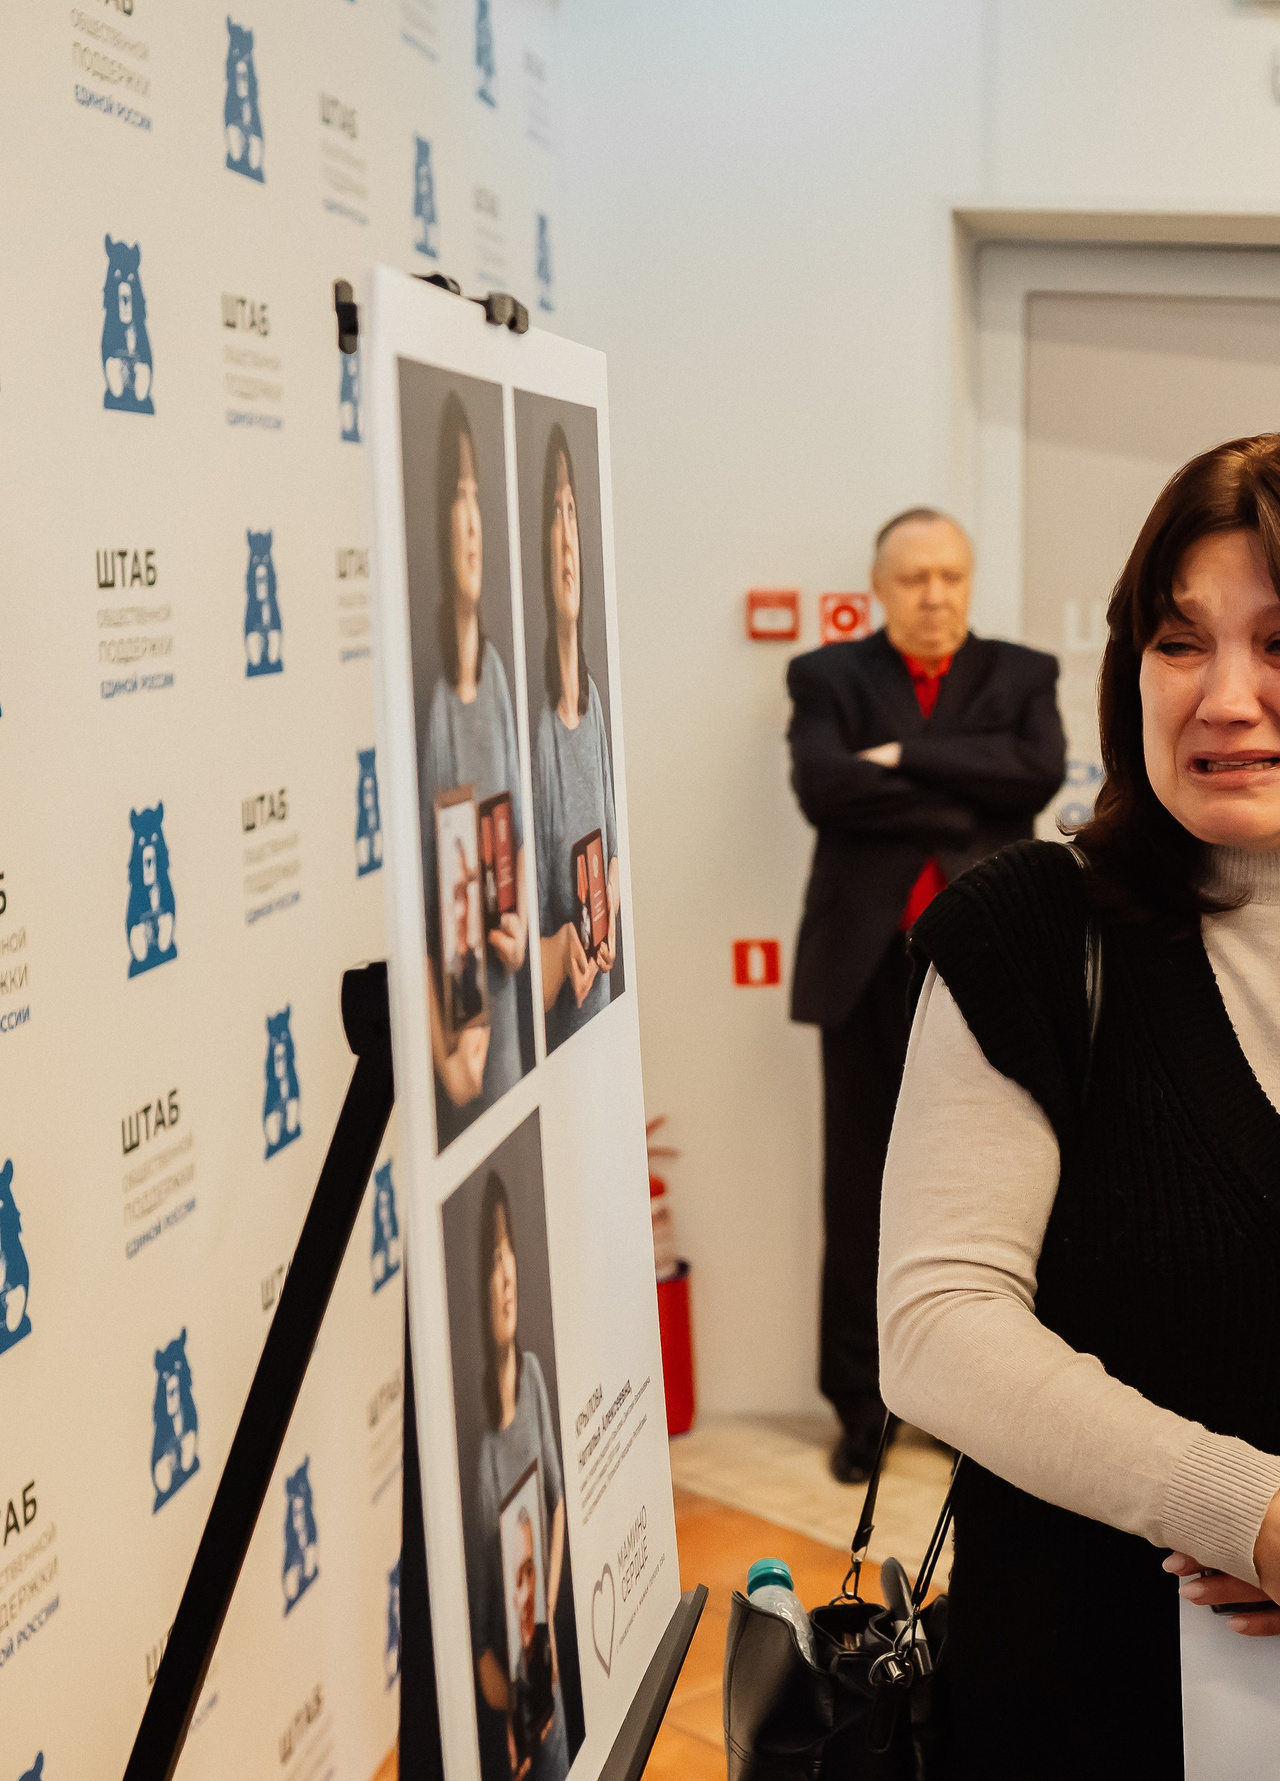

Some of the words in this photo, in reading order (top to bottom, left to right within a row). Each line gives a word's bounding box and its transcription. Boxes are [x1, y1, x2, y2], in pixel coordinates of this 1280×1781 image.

[96, 549, 157, 588] ШТАБ
[241, 786, 288, 832] ШТАБ
[121, 1088, 180, 1155] ШТАБ
[0, 1480, 37, 1547] АБ
[617, 1505, 646, 1576] МАМИНО
[621, 1536, 648, 1602] СЕРДЦЕ
